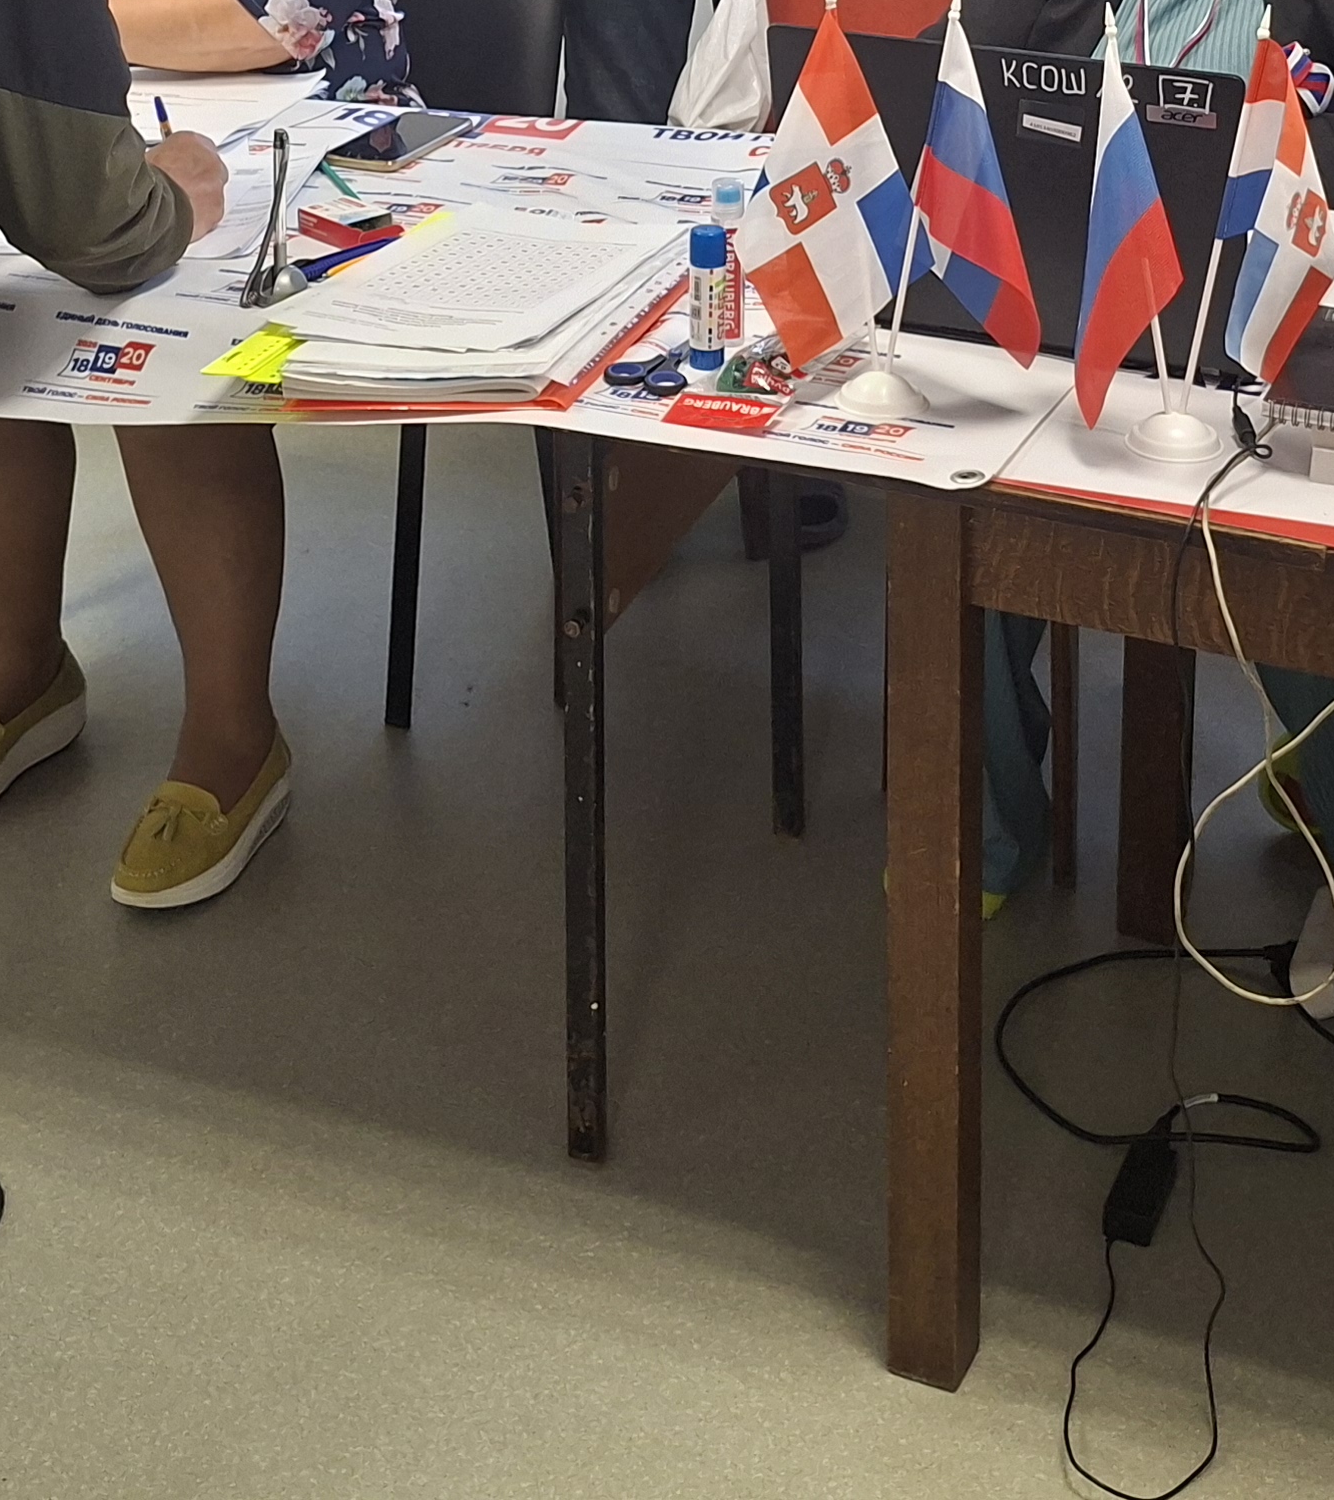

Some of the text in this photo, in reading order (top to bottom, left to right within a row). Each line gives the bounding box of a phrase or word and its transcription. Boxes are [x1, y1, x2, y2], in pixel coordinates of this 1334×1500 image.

[1001, 57, 1086, 96] КСОШ
[333, 108, 396, 126] 18
[1161, 109, 1204, 123] acer
[549, 175, 566, 184] 20
[56, 311, 189, 338] ЕДИНЫЙ ДЕНЬ ГОЛОСОВАНИЯ
[71, 348, 145, 372] 18 19 20
[89, 376, 136, 387] СЕНТЯБРЯ
[245, 383, 264, 395] 18
[609, 389, 632, 399] 18
[683, 398, 760, 415] BRAUBERG
[815, 423, 904, 436] 18 19 20
[792, 434, 829, 445] ГОЛОС
